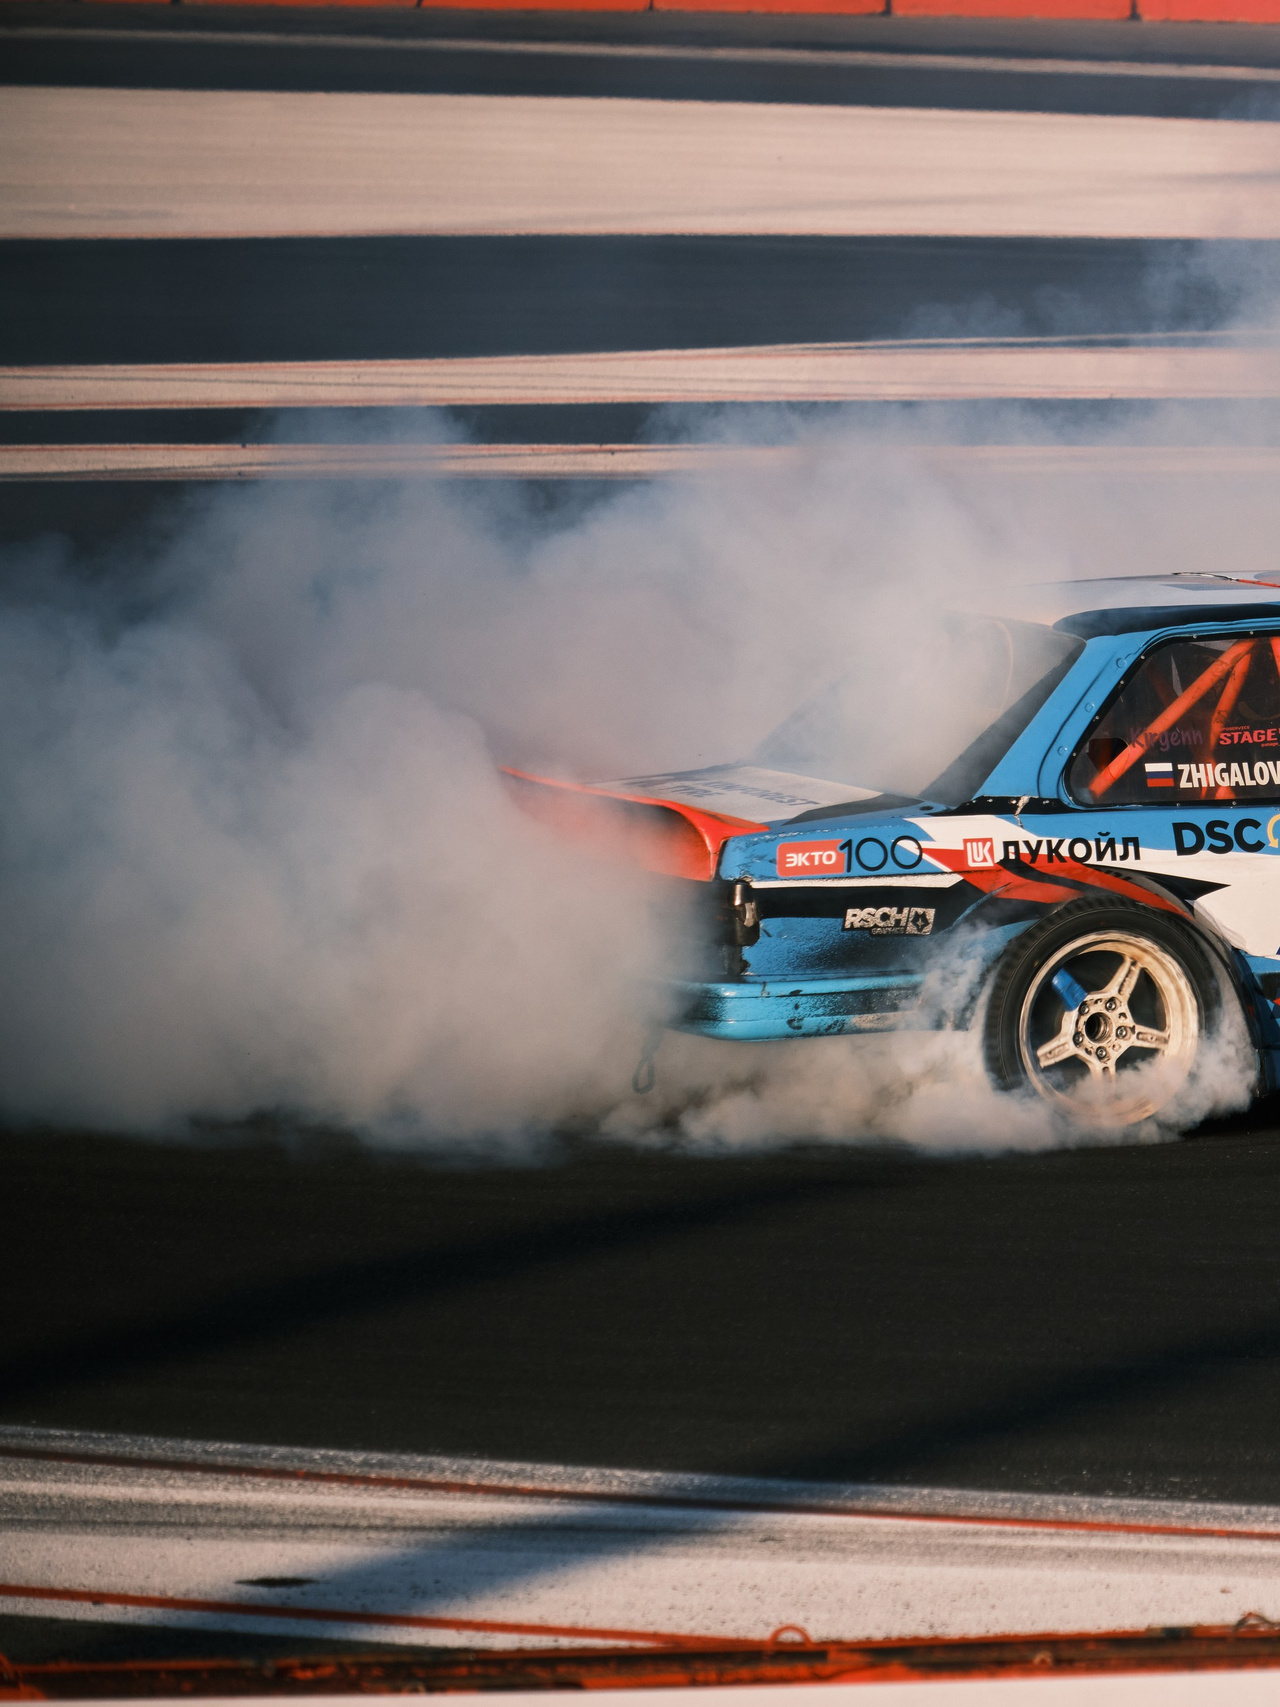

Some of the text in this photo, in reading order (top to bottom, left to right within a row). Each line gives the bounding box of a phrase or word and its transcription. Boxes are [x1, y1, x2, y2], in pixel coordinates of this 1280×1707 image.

[1219, 728, 1278, 746] STAGE
[785, 835, 924, 873] ЭКТО 100
[844, 907, 910, 930] RSCH
